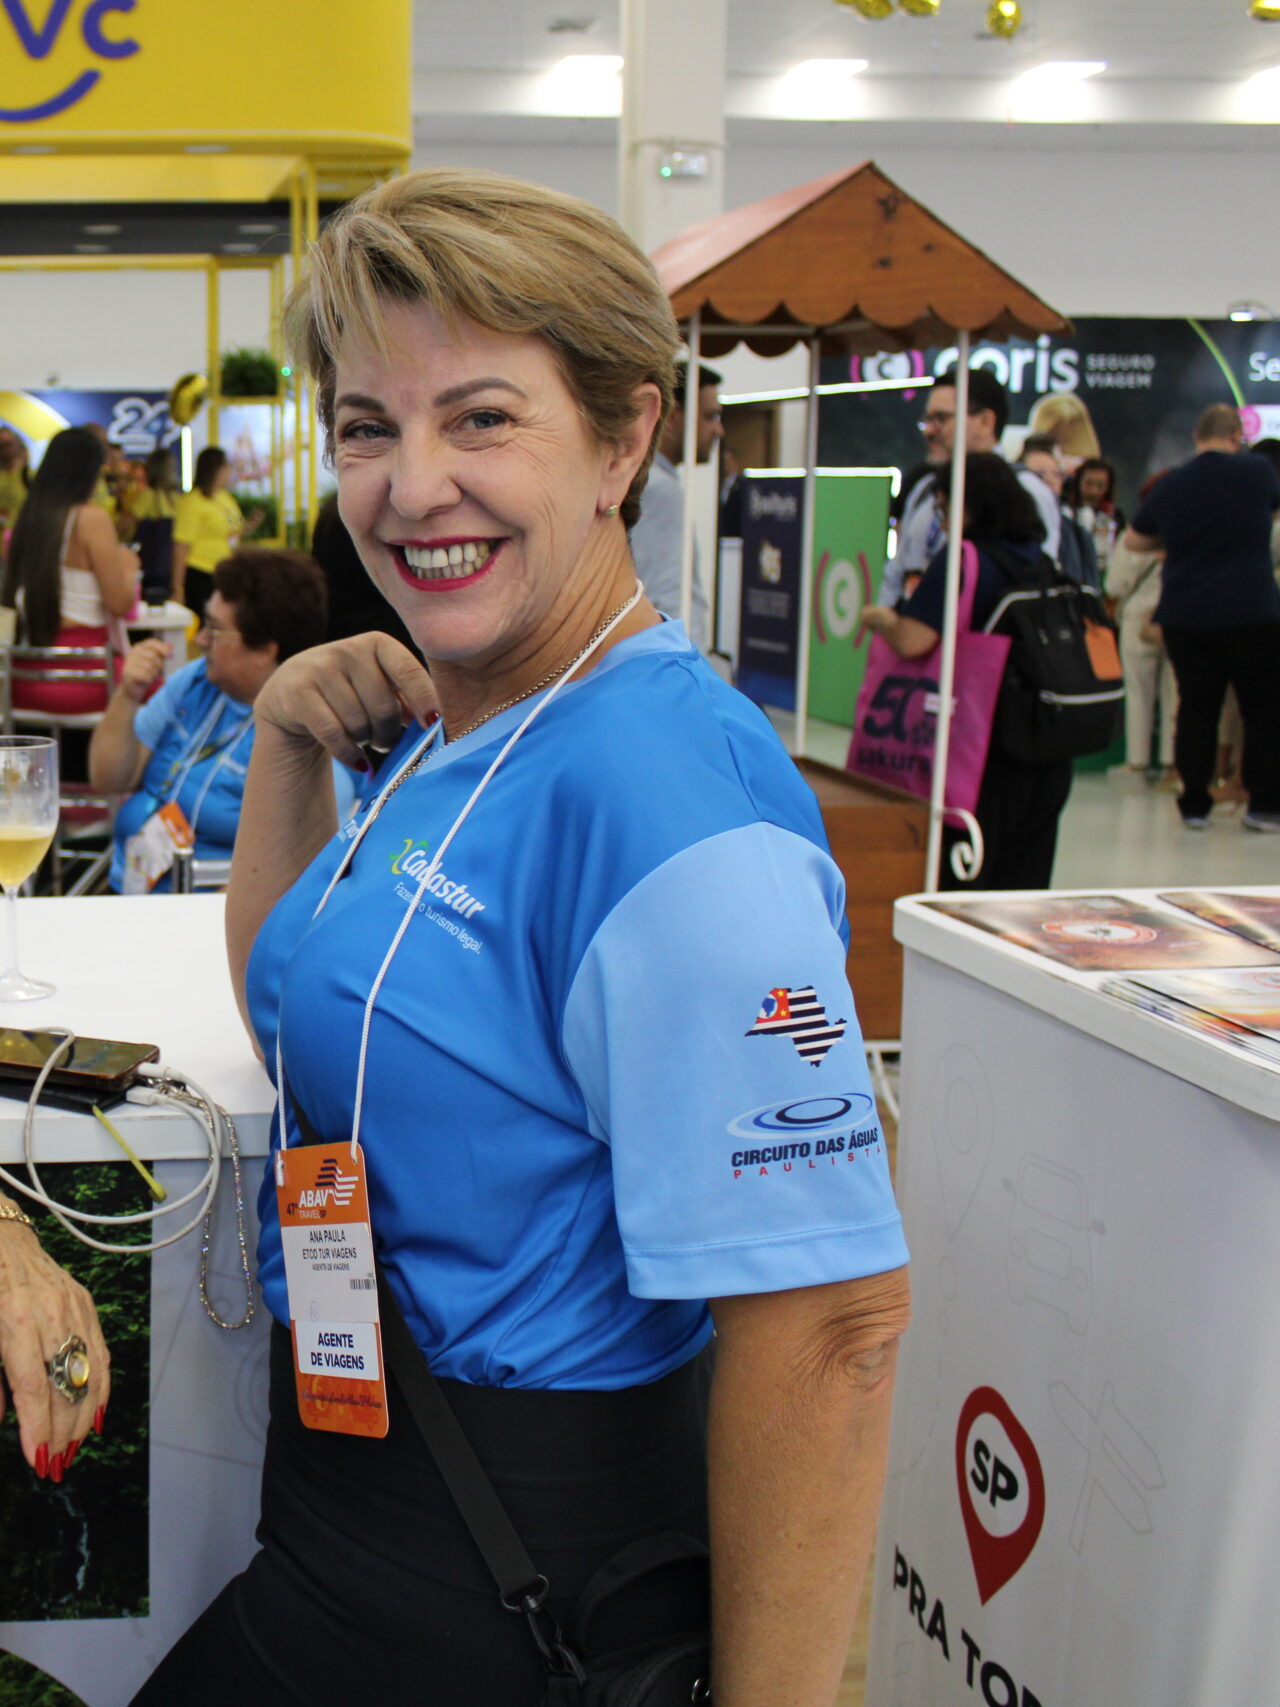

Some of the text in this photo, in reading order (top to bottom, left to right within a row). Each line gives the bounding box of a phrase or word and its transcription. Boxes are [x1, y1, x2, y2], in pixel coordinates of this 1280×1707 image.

[1086, 353, 1155, 371] SEGURO
[1086, 372, 1152, 389] VIAGEM
[401, 849, 486, 919] Cadastur
[425, 907, 459, 937] turismo
[731, 1127, 878, 1168] CIRCUITO DAS ÁGUAS
[299, 1189, 329, 1208] ABAV
[310, 1229, 346, 1243] ANA PAULA
[320, 1248, 331, 1259] TUR
[331, 1247, 357, 1259] VIAGENS
[318, 1332, 354, 1348] AGENTE
[310, 1352, 365, 1370] DE VIAGENS
[970, 1438, 1020, 1508] SP
[893, 1543, 951, 1662] PRA
